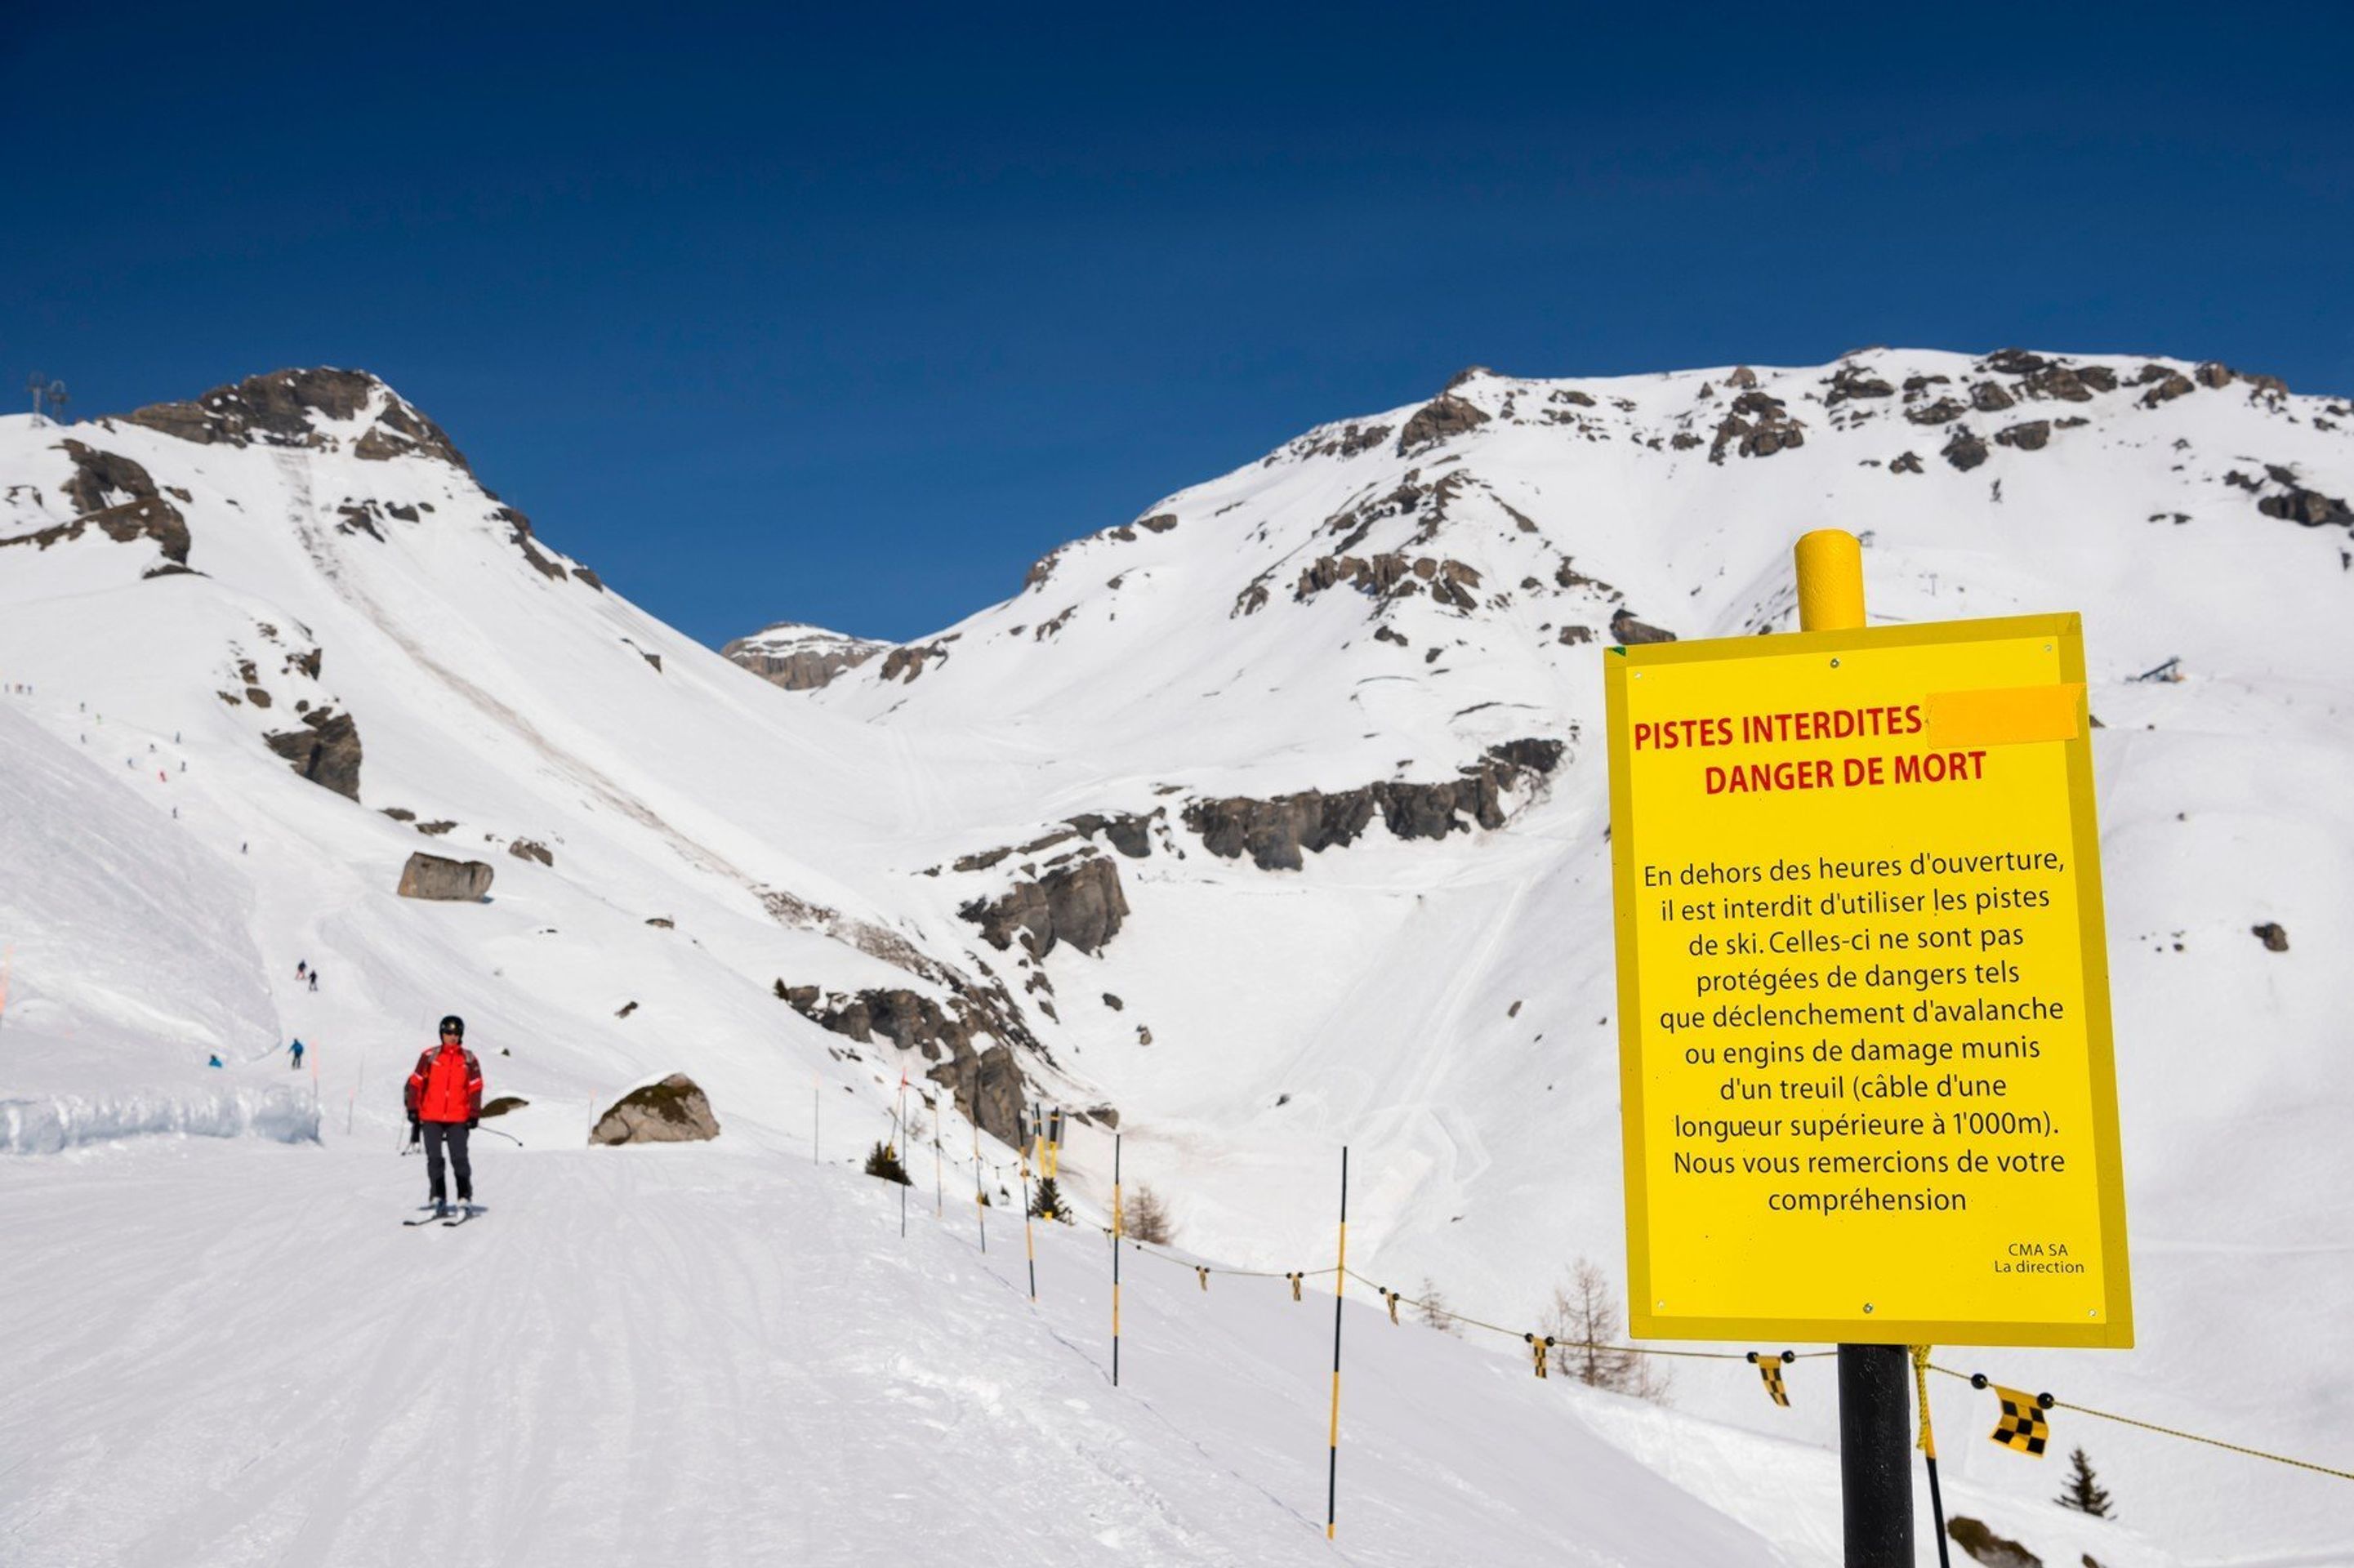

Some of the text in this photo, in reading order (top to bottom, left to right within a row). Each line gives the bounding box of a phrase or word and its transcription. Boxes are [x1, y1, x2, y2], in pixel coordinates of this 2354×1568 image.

[1634, 704, 1923, 751] PISTES INTERDITES
[1705, 751, 1987, 795] DANGER DE MORT
[1645, 852, 2064, 887] En dehors des heures d'ouverture,
[1662, 886, 2050, 921] il est interdit d'utiliser les pistes
[1688, 928, 2024, 956] de ski. Celles-ci ne sont pas
[1697, 960, 2020, 998] protégées de dangers tels
[1660, 996, 2064, 1035] que déclenchement d'avalanche
[1685, 1036, 2040, 1070] ou engins de damage munis
[1720, 1073, 2007, 1102] d'un treuil (câble d'une
[1675, 1110, 2059, 1143] longueur supérieure à 1'000m).
[1674, 1148, 2065, 1174] Nous vous remercions de votre
[1768, 1187, 1966, 1217] compréhension
[1994, 1259, 2084, 1274] La direction
[2008, 1243, 2069, 1257] CMA SA
